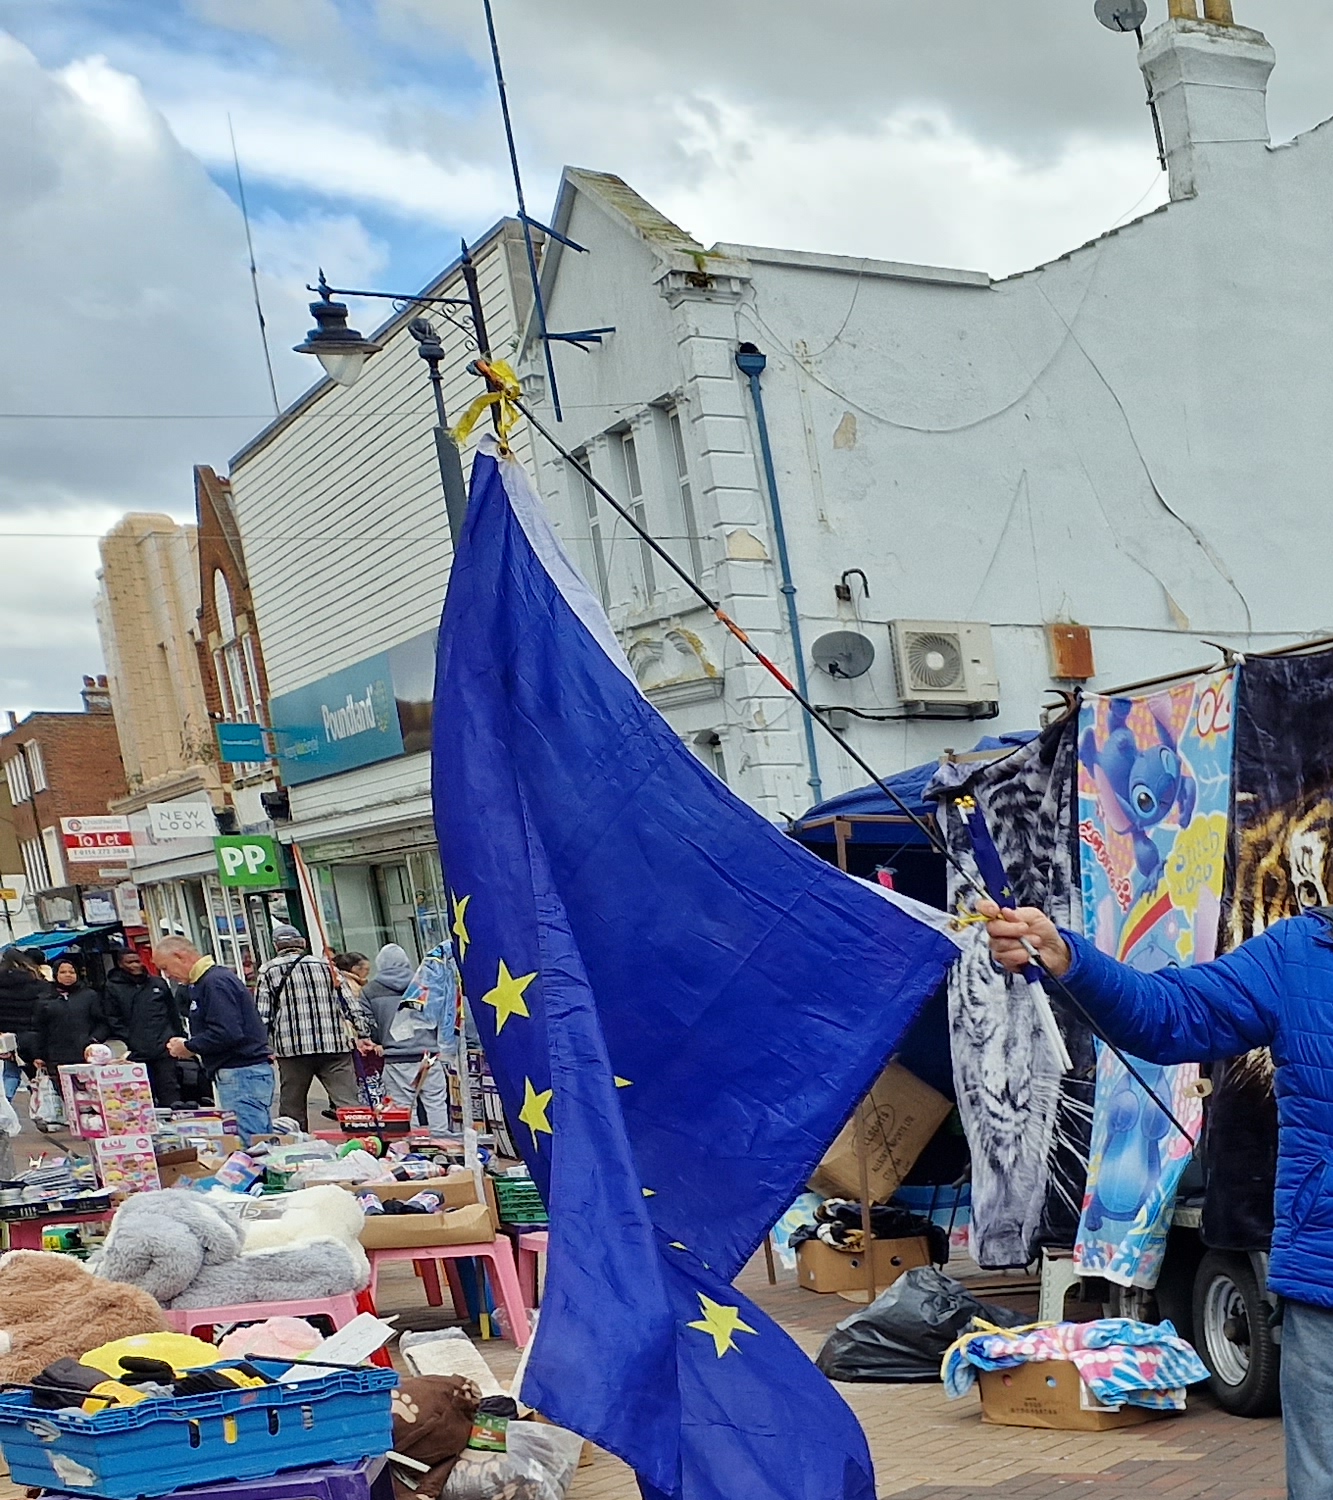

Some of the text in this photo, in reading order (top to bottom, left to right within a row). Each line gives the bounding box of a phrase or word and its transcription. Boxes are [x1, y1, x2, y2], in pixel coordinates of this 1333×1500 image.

[321, 684, 376, 743] Poundland
[159, 811, 199, 821] NEW
[158, 820, 206, 832] LOOK
[74, 832, 121, 847] To Let
